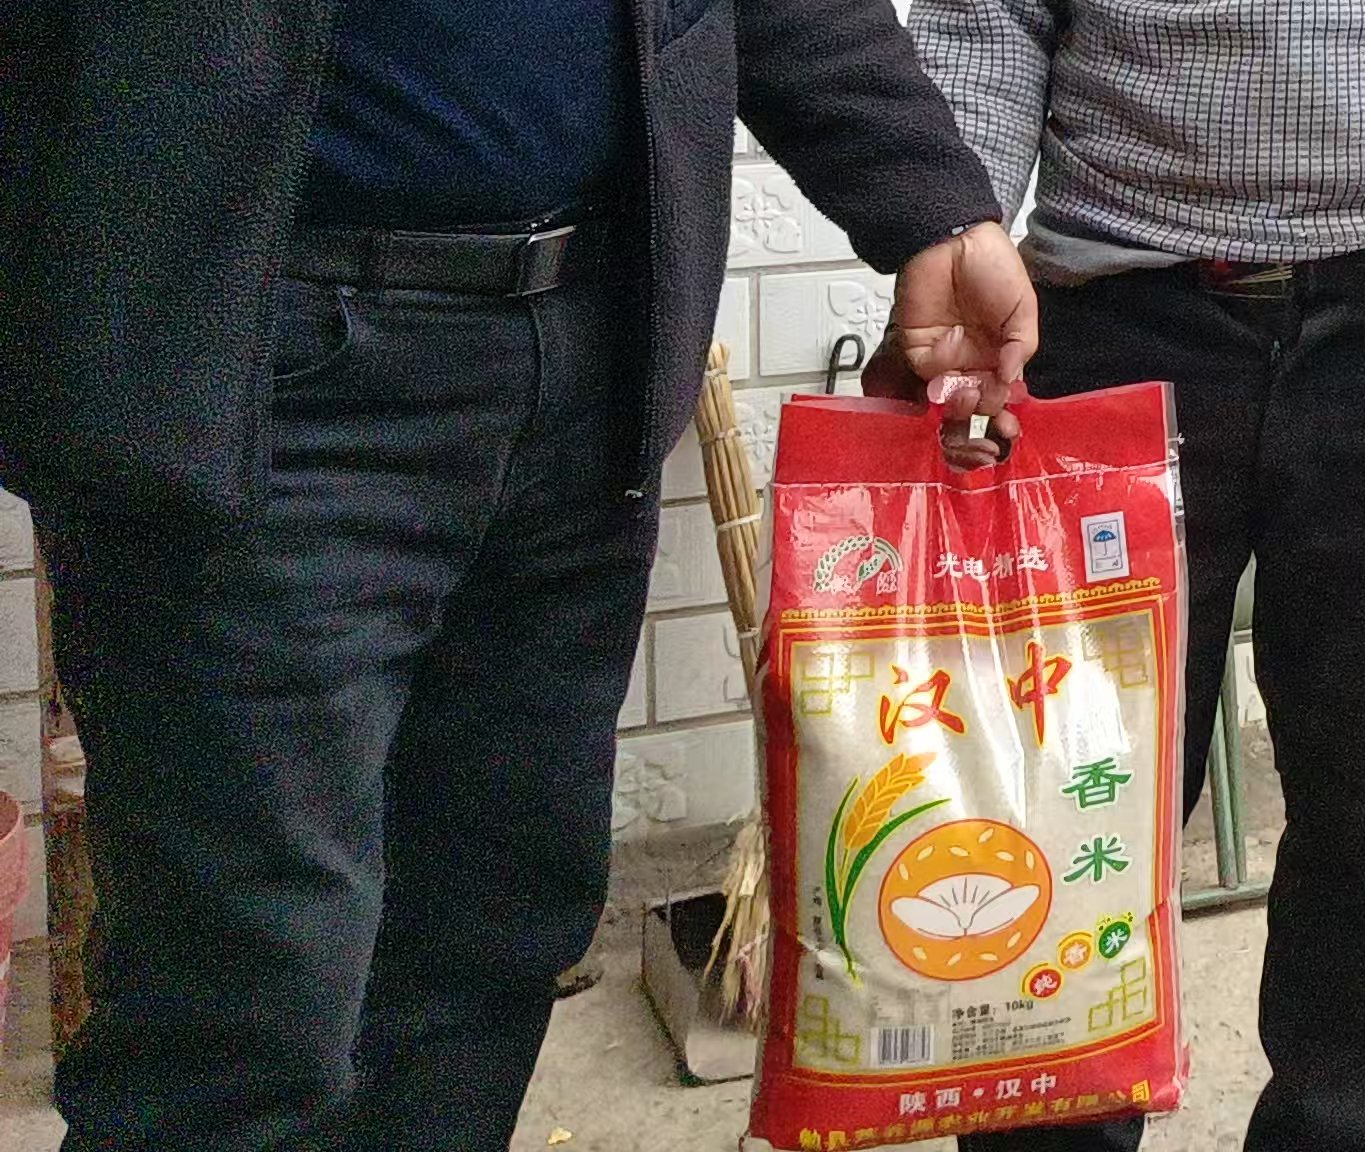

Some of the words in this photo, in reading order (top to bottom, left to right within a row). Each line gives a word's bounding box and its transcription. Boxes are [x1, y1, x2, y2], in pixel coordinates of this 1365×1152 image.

[933, 545, 1049, 582] 光电精选
[879, 642, 1072, 745] 汉中
[1062, 757, 1132, 882] 香米
[1005, 999, 1034, 1013] 10kg
